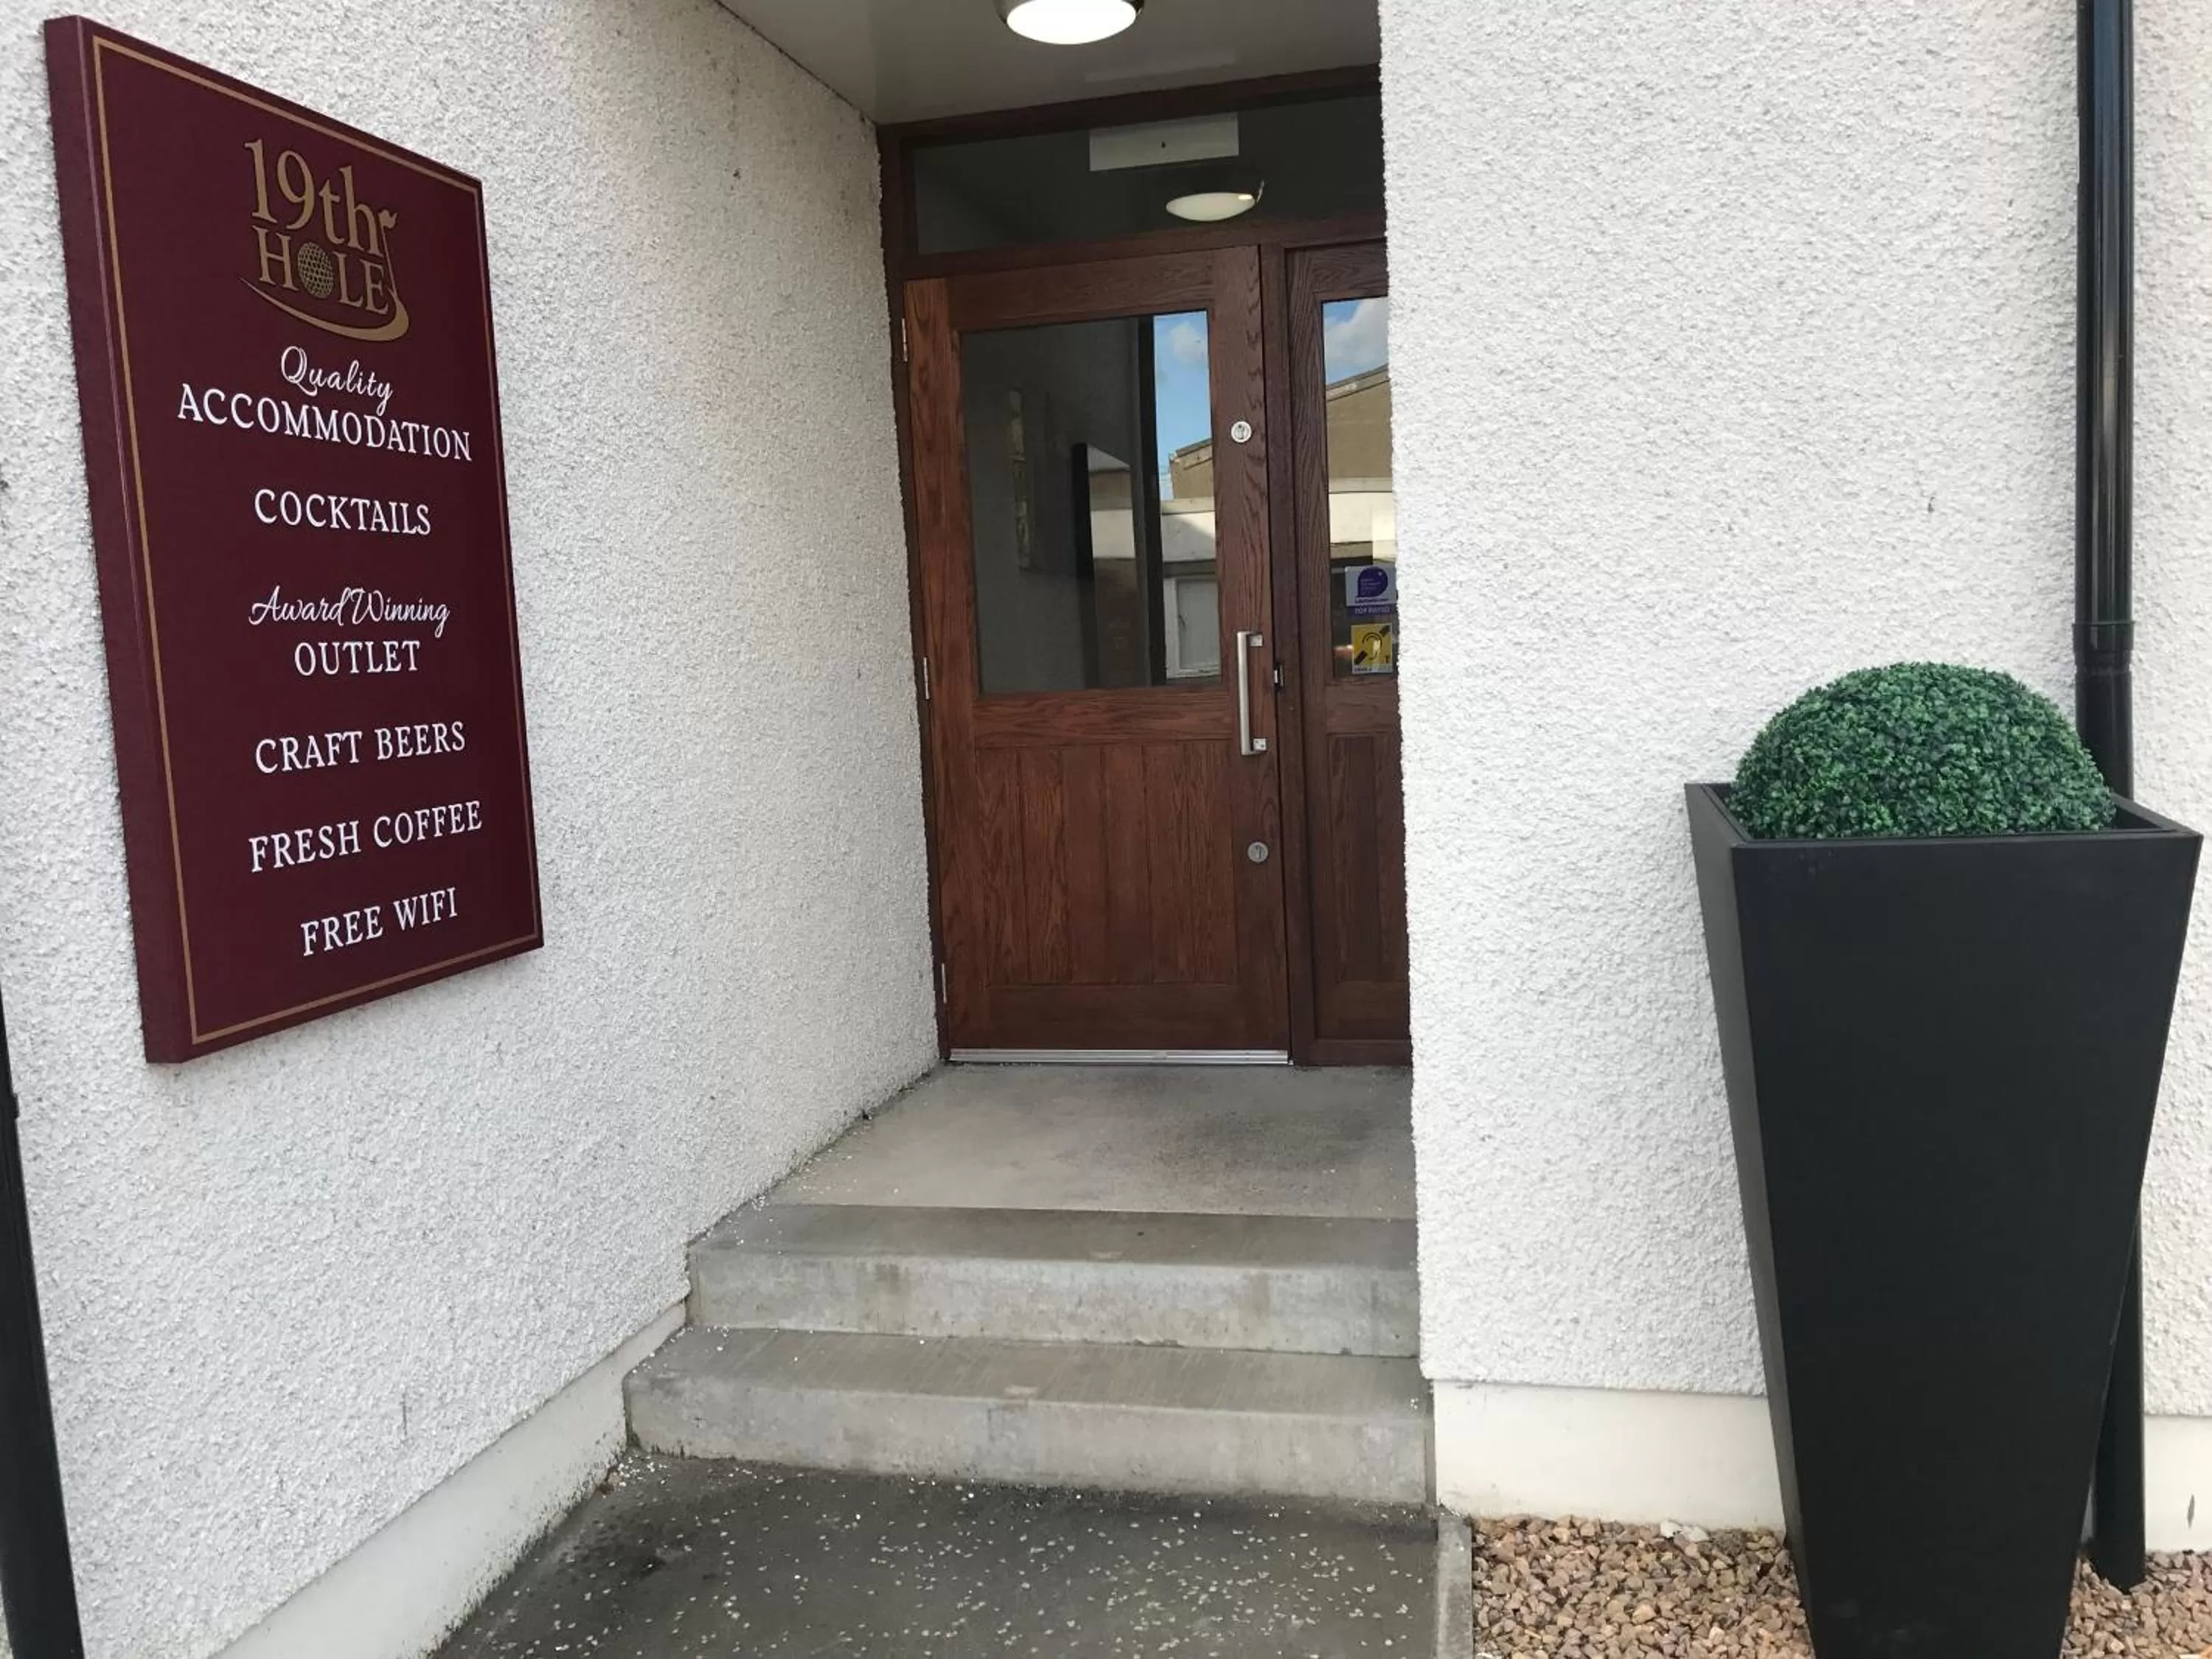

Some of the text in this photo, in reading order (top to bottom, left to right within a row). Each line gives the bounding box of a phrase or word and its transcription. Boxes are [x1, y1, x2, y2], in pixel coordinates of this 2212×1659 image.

[244, 138, 384, 257] 19th
[251, 225, 389, 315] HOLE
[281, 346, 393, 415] Quality
[177, 383, 472, 462] ACCOMMODATION
[254, 488, 431, 535] COCKTAILS
[248, 585, 451, 639] Award Winning
[294, 640, 420, 676] OUTLET
[255, 720, 466, 773] CRAFT BEERS
[248, 800, 483, 873] FRESH COFFEE
[300, 887, 459, 956] FREE WIFI
